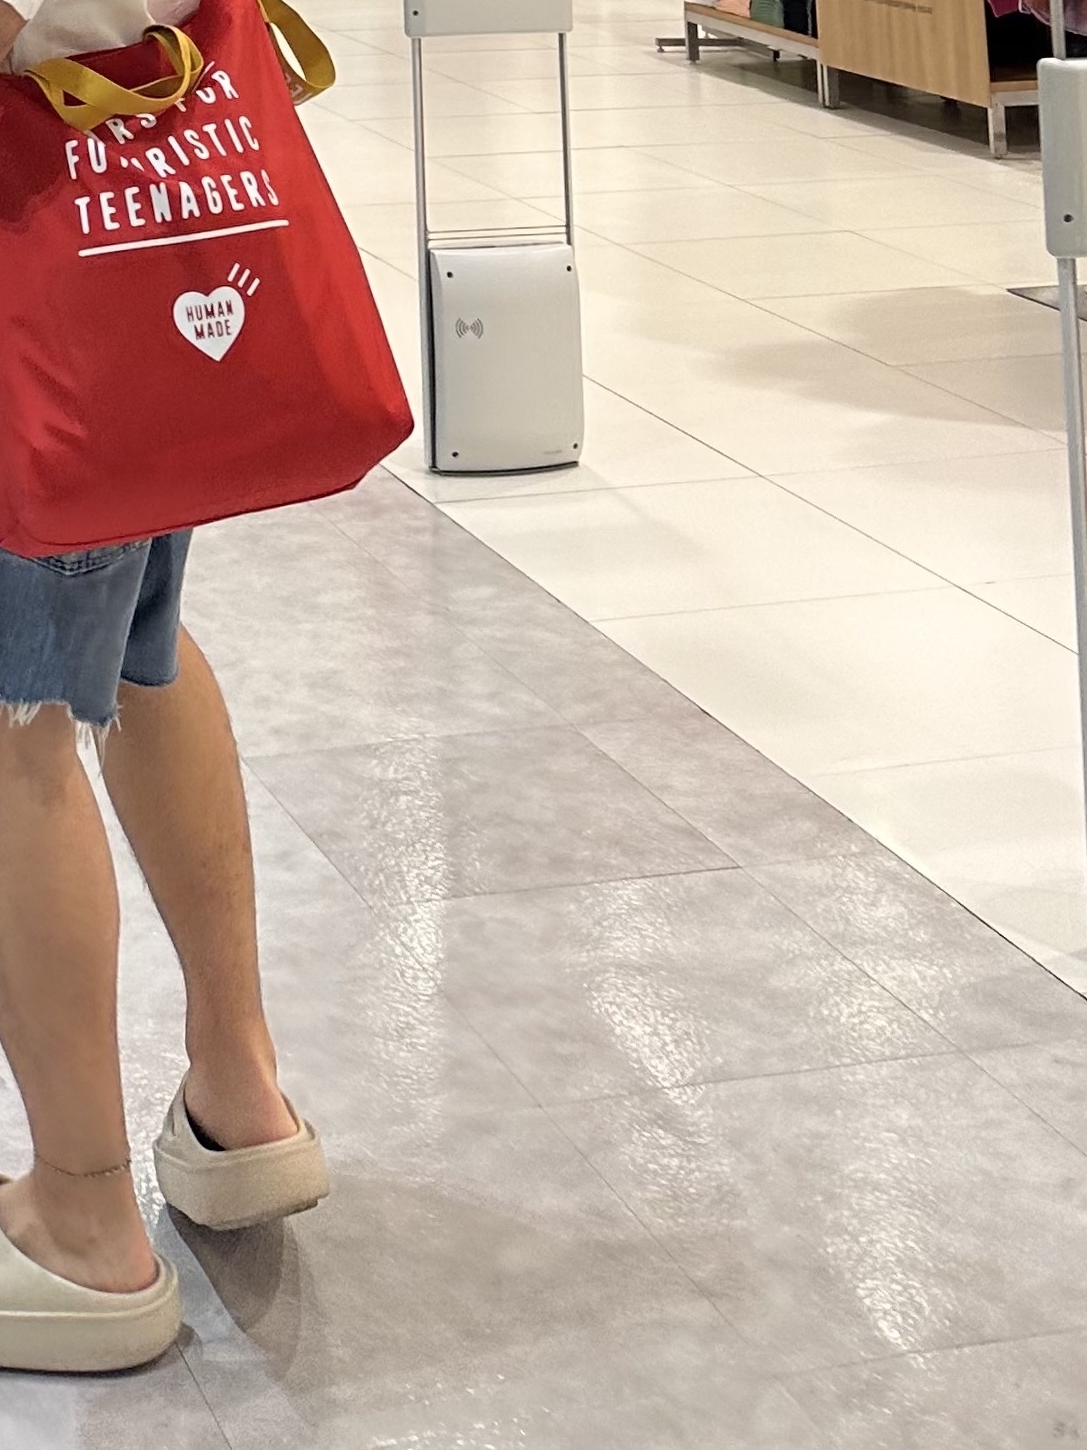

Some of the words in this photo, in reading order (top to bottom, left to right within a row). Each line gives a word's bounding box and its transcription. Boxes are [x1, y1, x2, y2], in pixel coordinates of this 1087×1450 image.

[65, 116, 260, 180] FURISTIC
[74, 169, 280, 234] TEENAGERS
[185, 300, 234, 322] HUMAN
[194, 319, 233, 340] MADE
